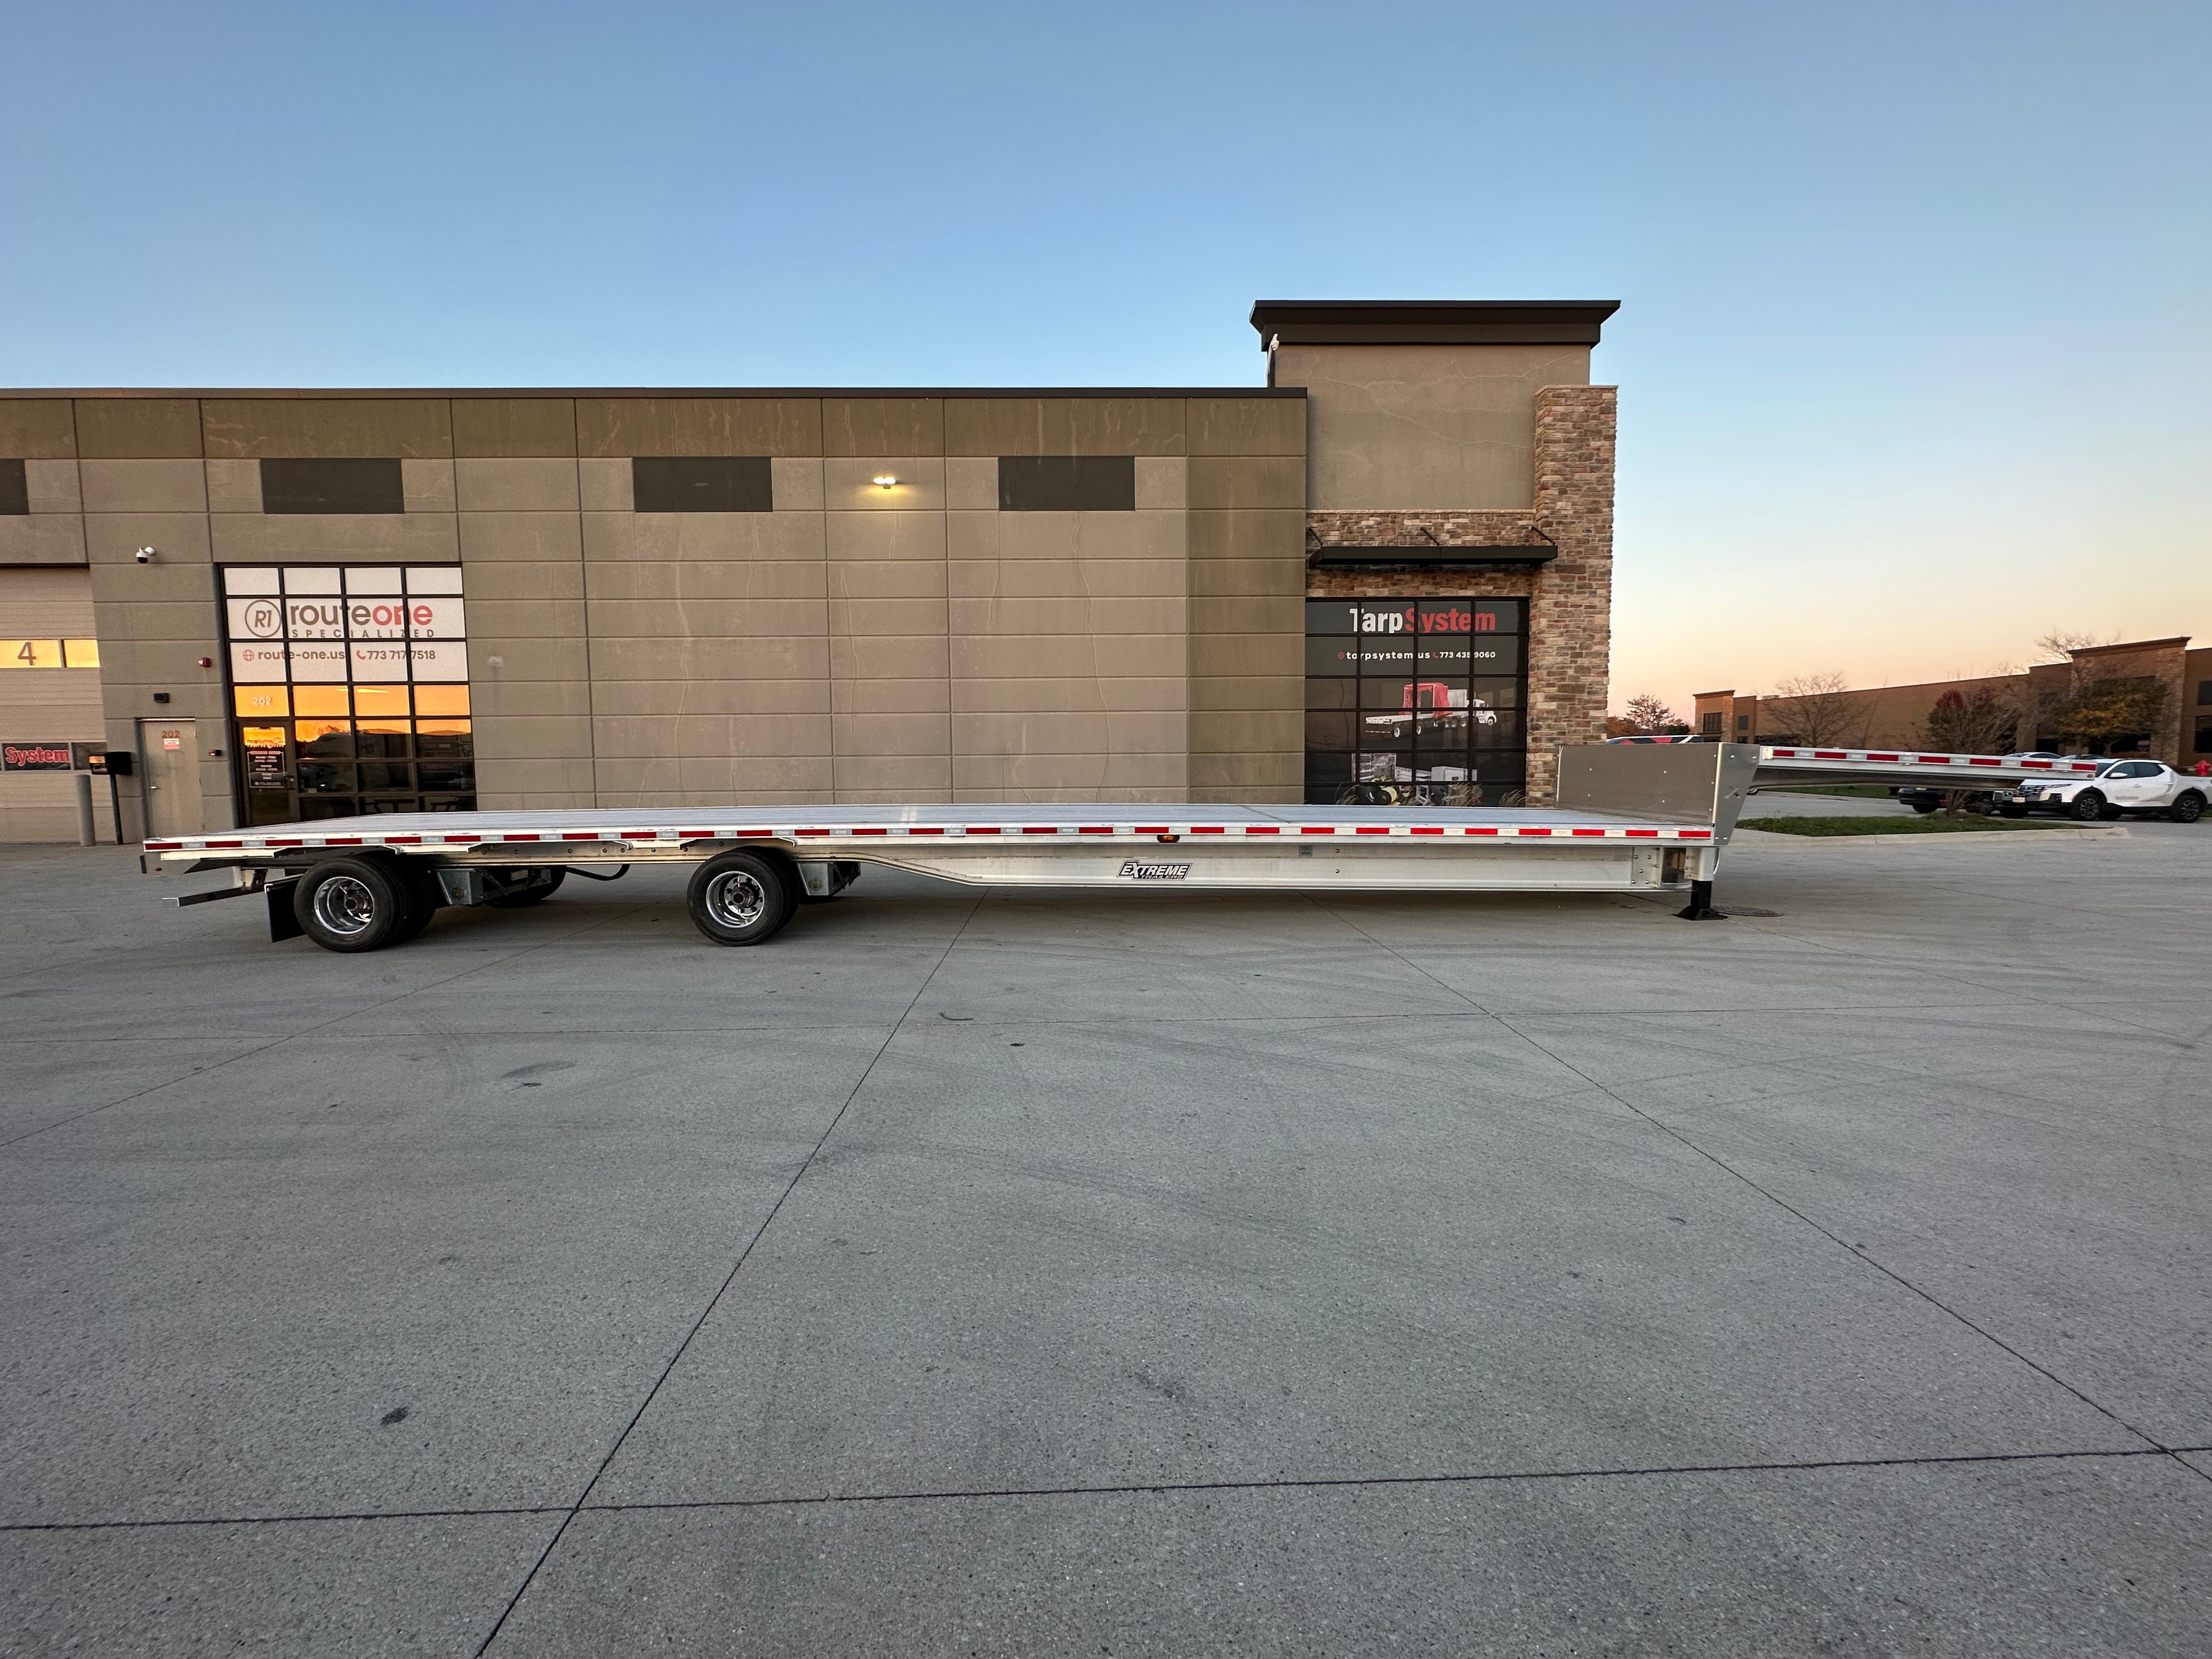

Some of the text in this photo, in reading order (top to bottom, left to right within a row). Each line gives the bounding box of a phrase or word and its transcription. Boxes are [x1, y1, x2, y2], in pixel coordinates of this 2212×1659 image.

[255, 610, 272, 628] R1
[1350, 607, 1496, 633] TarpSystem
[292, 629, 434, 637] SPECIALIZED
[18, 641, 36, 665] 4
[258, 650, 436, 659] route-one.us 773 717 7518
[253, 697, 272, 706] 202
[162, 730, 180, 738] 202
[5, 747, 70, 766] System
[1120, 862, 1188, 878] EXTREME
